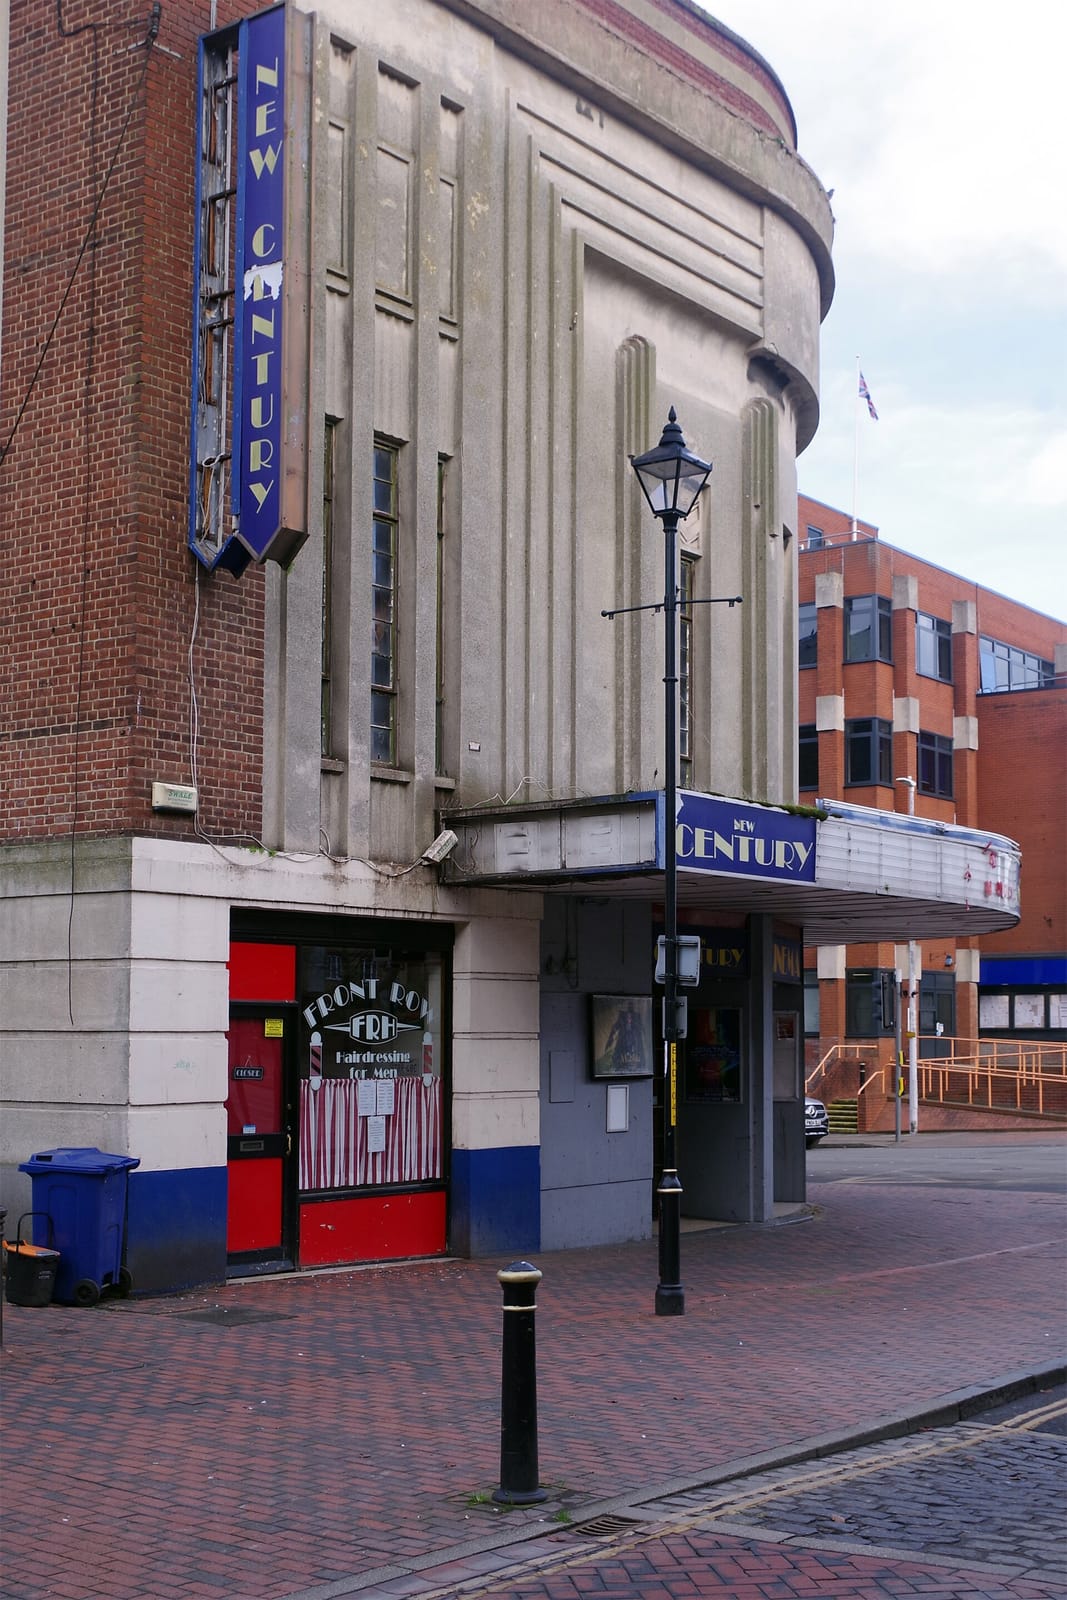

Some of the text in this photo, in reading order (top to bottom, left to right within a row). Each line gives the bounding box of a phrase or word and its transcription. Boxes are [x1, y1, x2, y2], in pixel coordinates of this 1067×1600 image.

[249, 56, 283, 180] NEW
[733, 818, 755, 833] NEW
[675, 823, 814, 872] CENTURY
[302, 978, 434, 1029] FRONT ROW
[352, 1014, 396, 1041] FRH
[335, 1049, 411, 1064] Hairdressing
[349, 1066, 398, 1080] for Men
